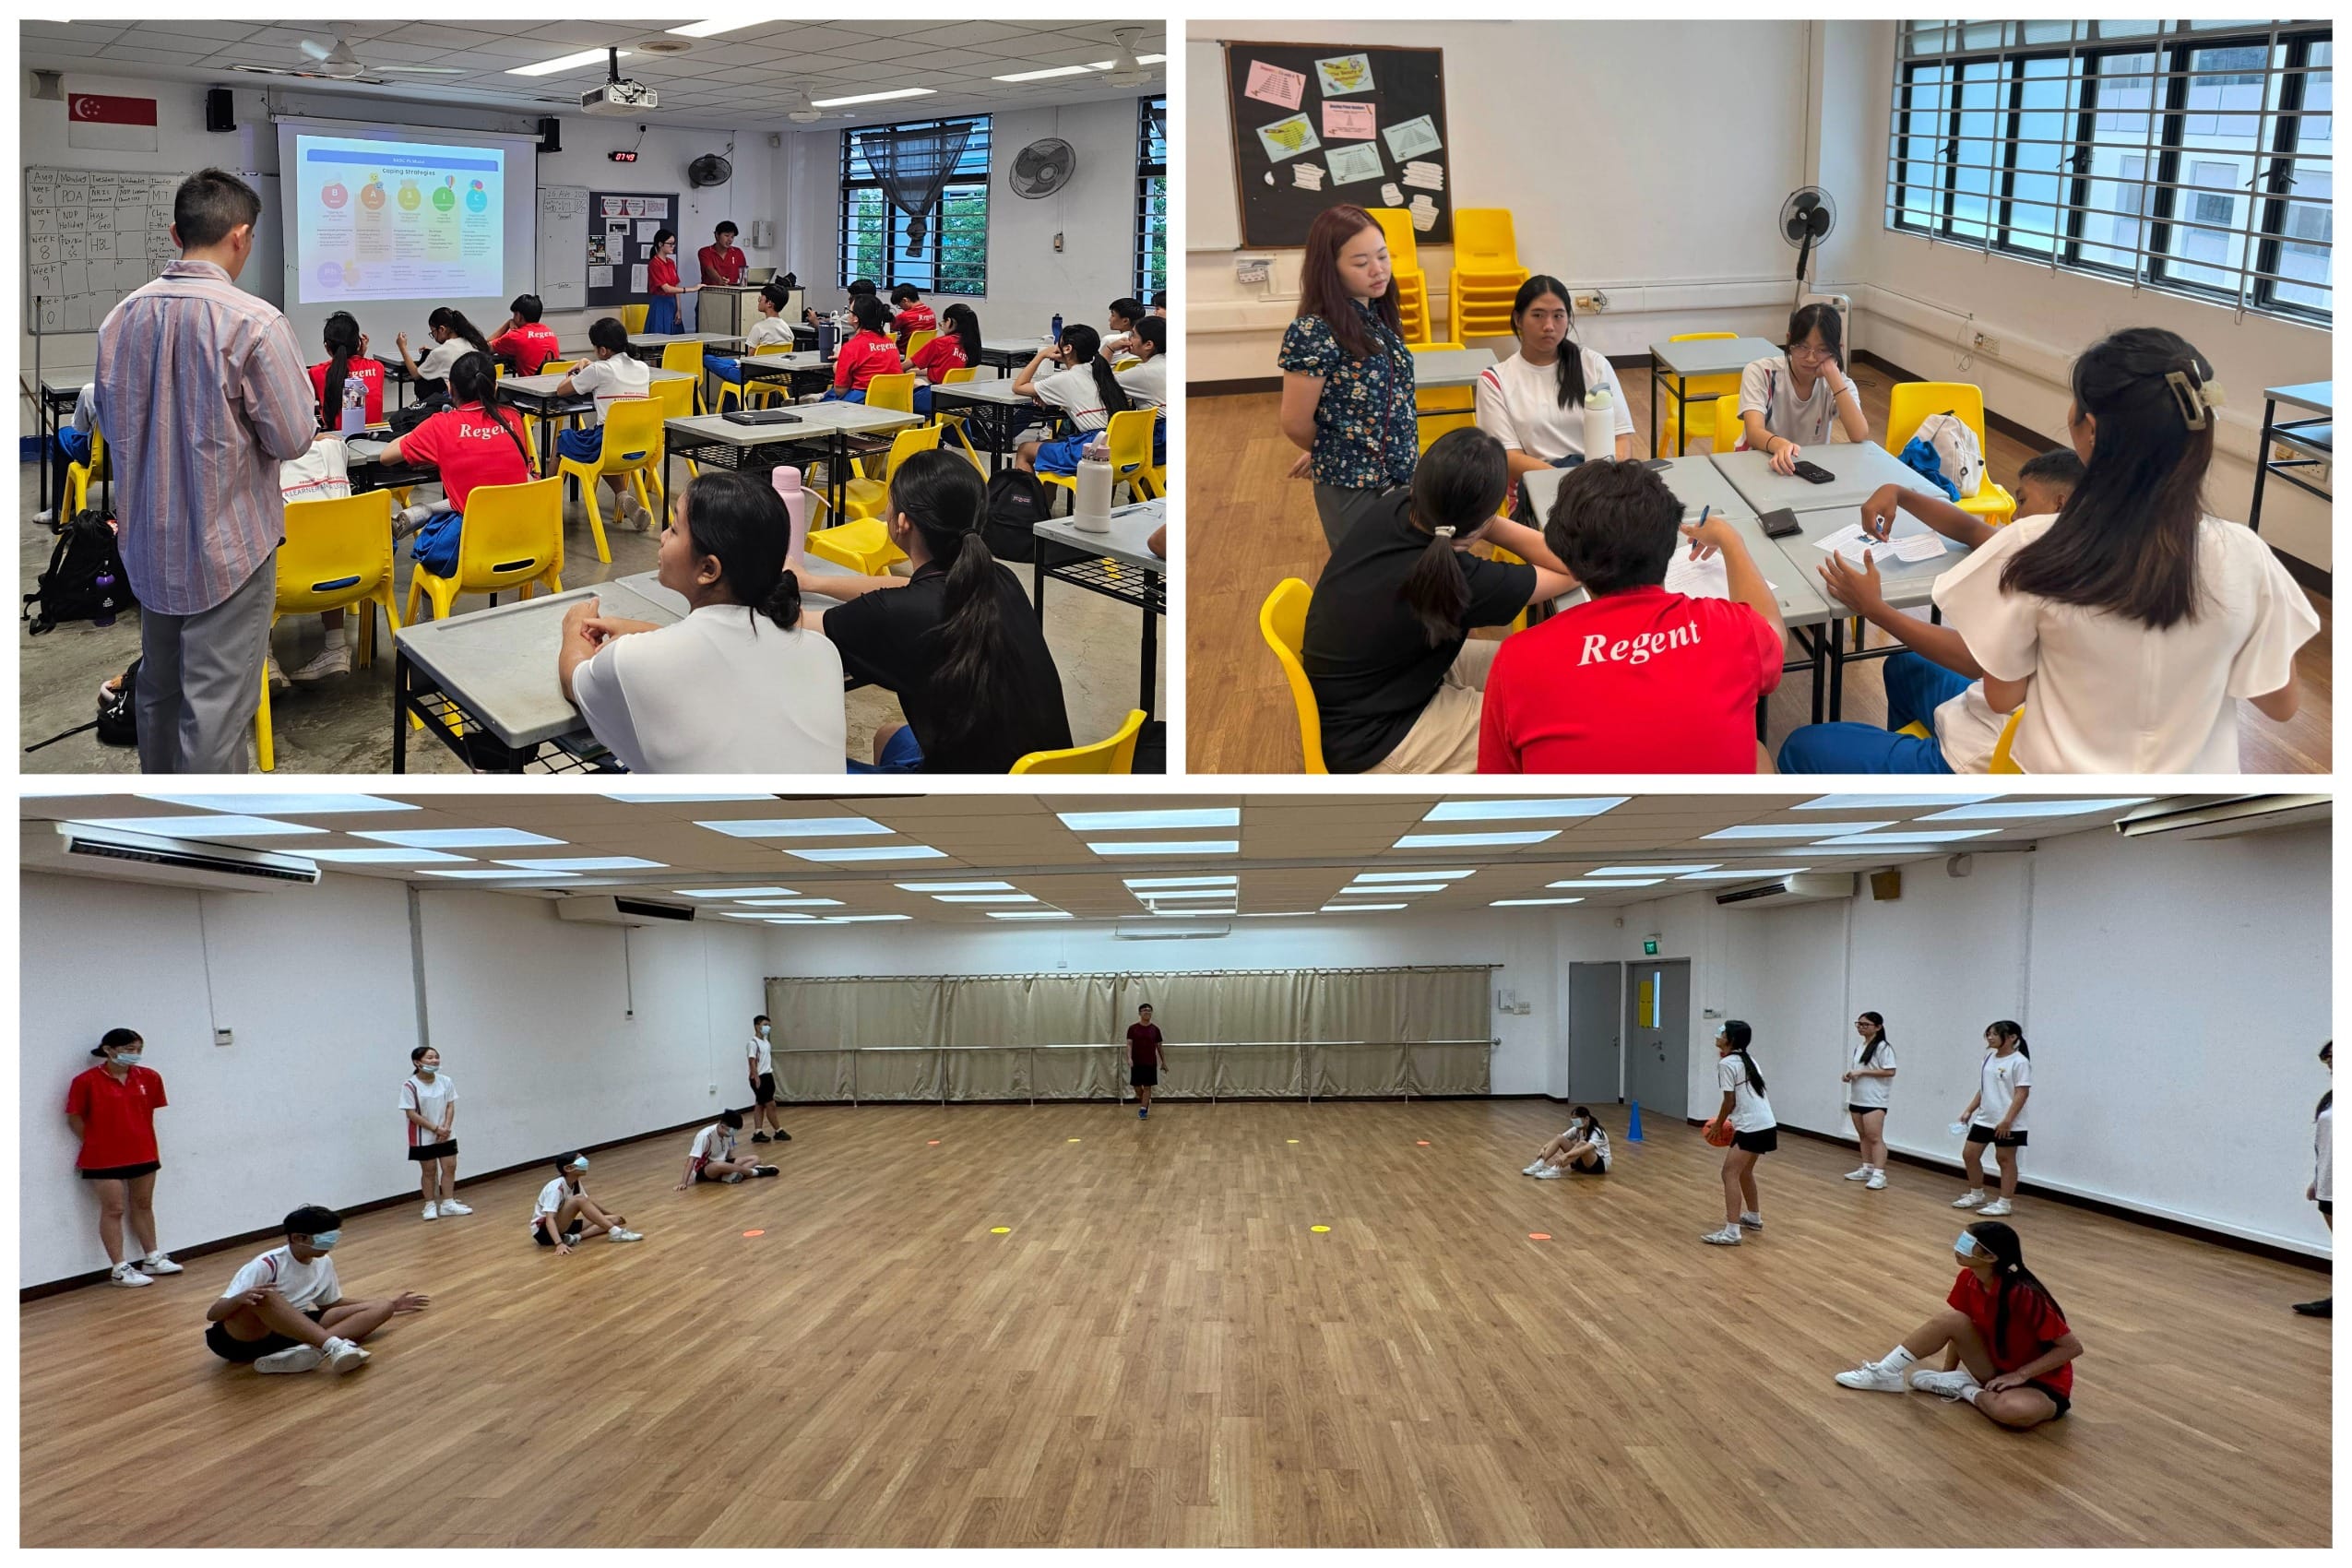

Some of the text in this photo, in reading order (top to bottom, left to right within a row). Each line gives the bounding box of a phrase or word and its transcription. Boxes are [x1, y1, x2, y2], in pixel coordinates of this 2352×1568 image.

[382, 168, 436, 177] Coping Strategies
[34, 172, 53, 184] Aug
[60, 173, 87, 184] Monday
[332, 188, 339, 196] B
[370, 190, 377, 198] A
[37, 194, 43, 204] 6
[38, 220, 45, 231] 7
[39, 244, 50, 260] 8
[42, 276, 50, 291] 9
[528, 330, 554, 339] Regen
[869, 342, 897, 352] Regen
[1575, 619, 1702, 667] Regent
